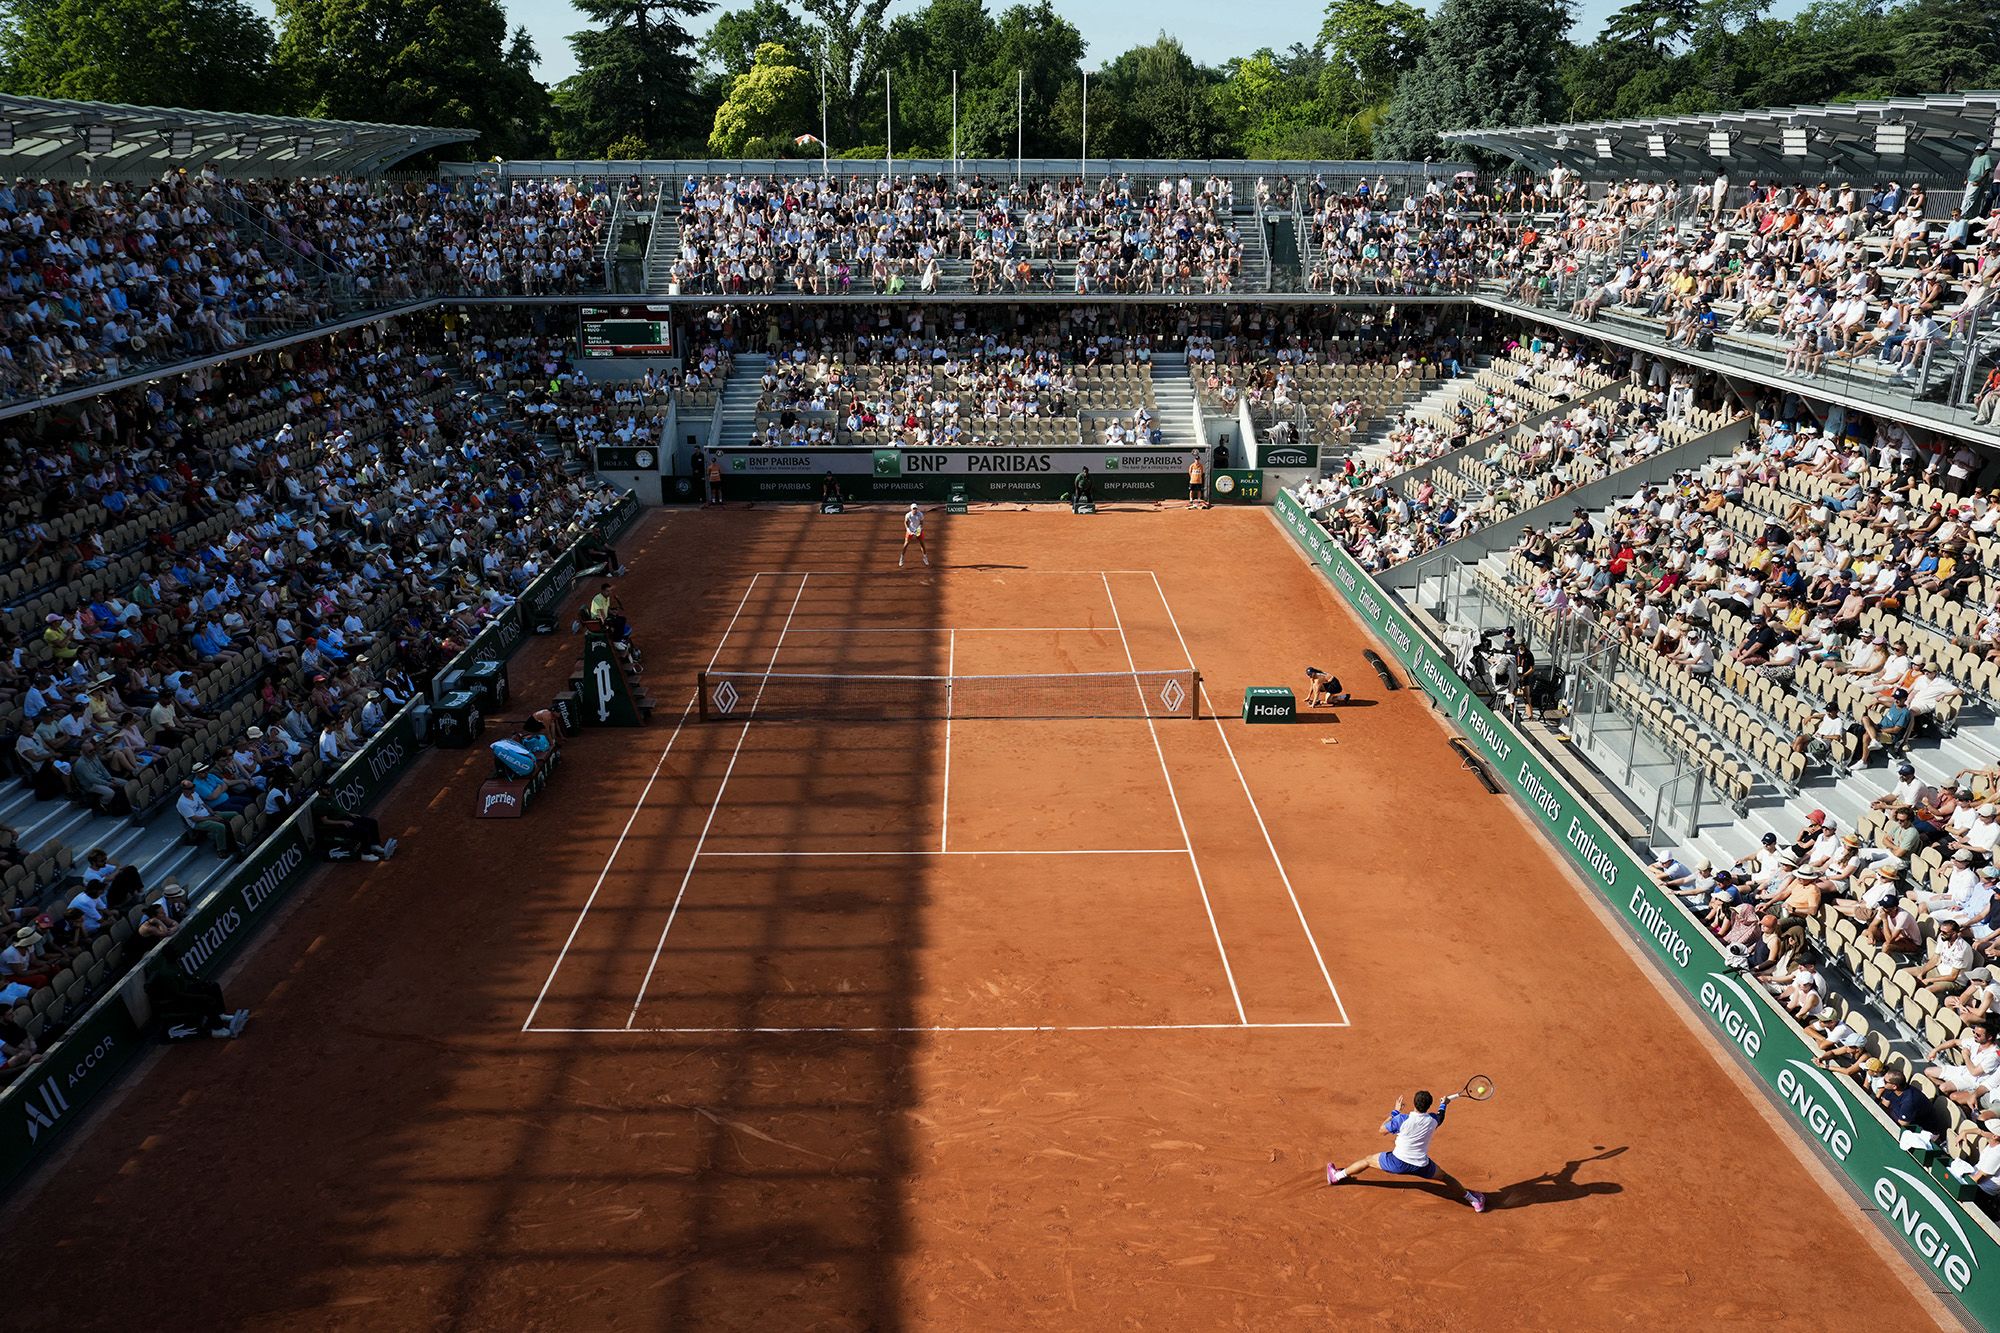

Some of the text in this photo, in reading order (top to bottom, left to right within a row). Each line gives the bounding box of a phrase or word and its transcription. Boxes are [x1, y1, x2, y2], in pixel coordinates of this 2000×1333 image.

[749, 457, 810, 466] BNP PARIBAS
[907, 455, 1051, 472] BNP PARIBAS
[1122, 457, 1183, 465] BNP PARIBAS
[760, 482, 811, 490] BNP PARIBAS
[873, 482, 924, 490] BNP PARIBAS
[990, 482, 1041, 490] BNP PARIBAS
[1241, 488, 1258, 496] 1:17
[1308, 531, 1321, 552] Haier
[1320, 545, 1334, 566] Haier
[553, 563, 576, 592] Emirates
[1336, 560, 1356, 592] Emirates
[1358, 586, 1382, 621] Emirates
[1385, 614, 1411, 653] Emirates
[1422, 658, 1458, 702] RENAULT
[558, 701, 572, 728] Wilson
[1254, 704, 1290, 716] Haier
[1469, 710, 1512, 762] RENAULT
[367, 736, 404, 782] Infosys
[498, 752, 530, 770] HEAD
[334, 776, 365, 811] fosys
[484, 792, 516, 814] perrier
[1518, 760, 1562, 822] Emirates
[1566, 816, 1618, 886] Emirates
[240, 842, 303, 913] Emirates
[1628, 884, 1692, 968] Emirates
[180, 906, 241, 976] mirates
[68, 1036, 115, 1088] ACCOR
